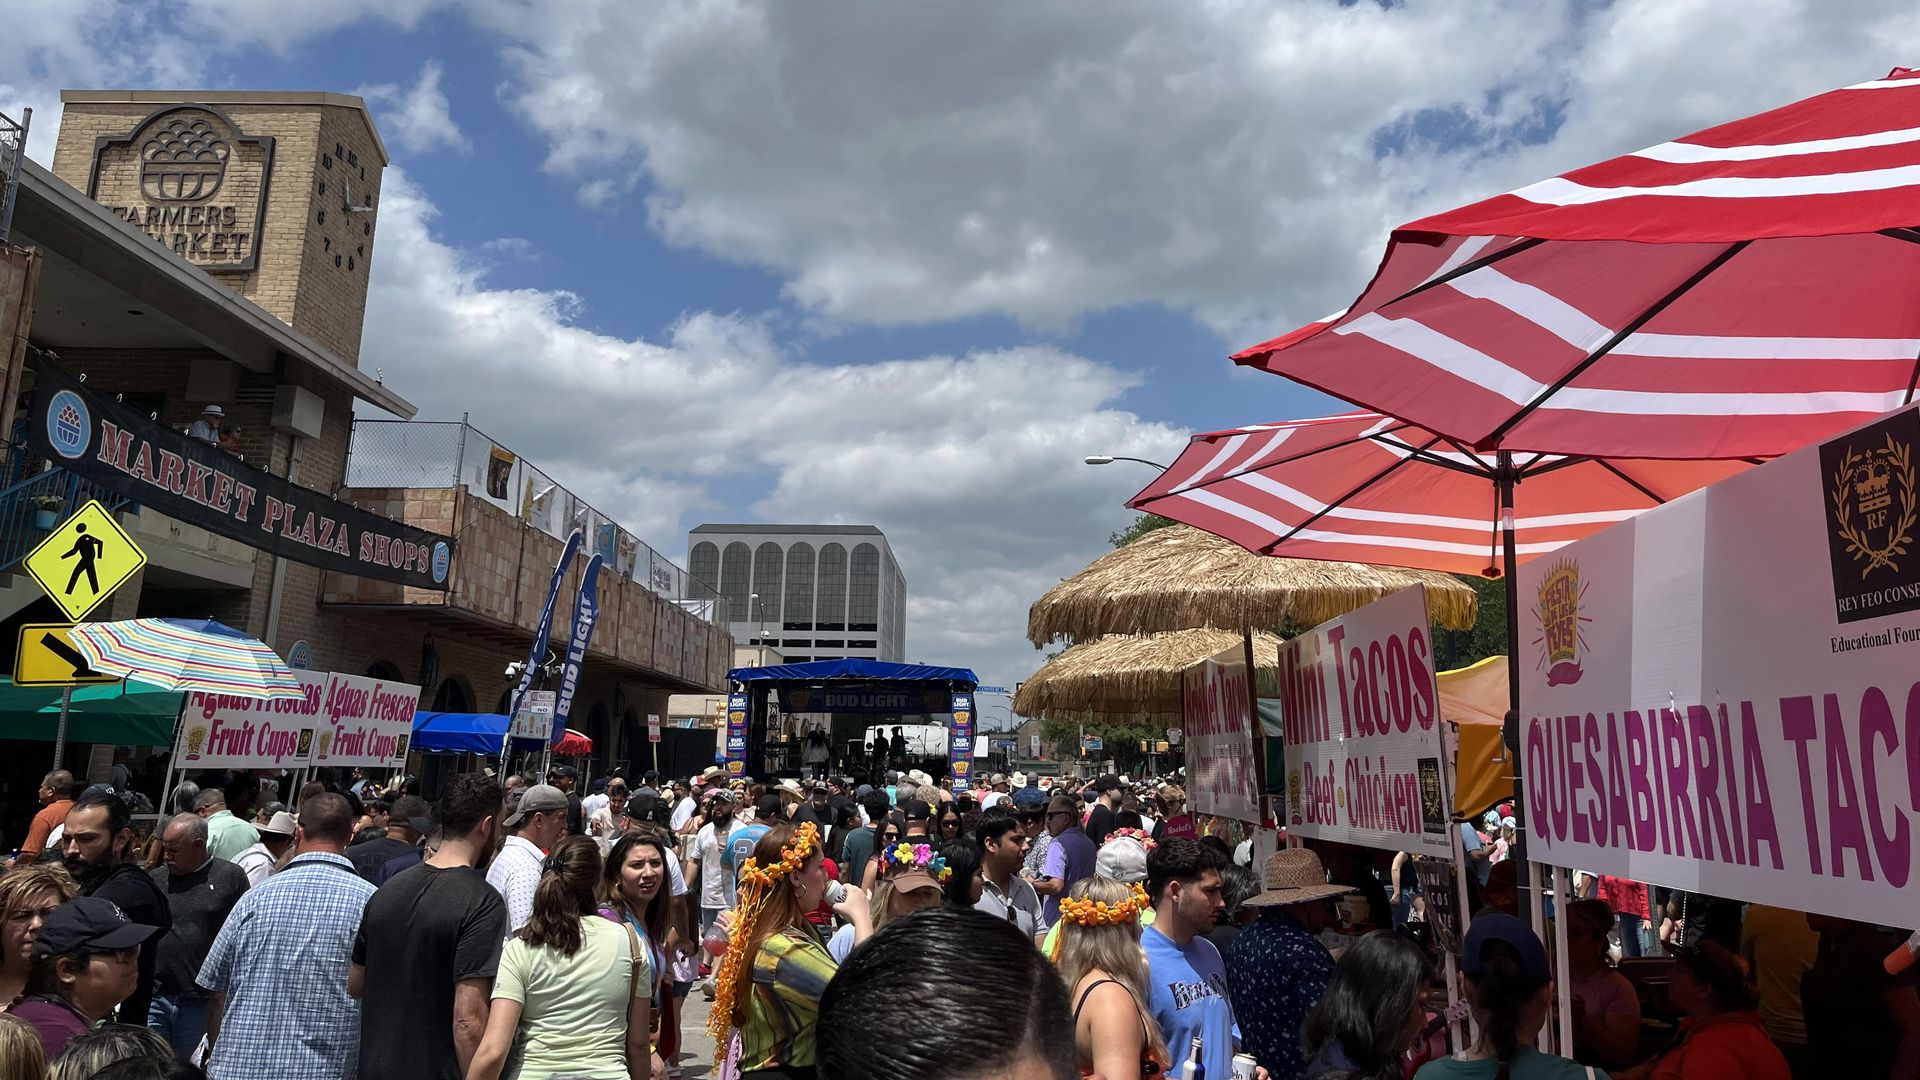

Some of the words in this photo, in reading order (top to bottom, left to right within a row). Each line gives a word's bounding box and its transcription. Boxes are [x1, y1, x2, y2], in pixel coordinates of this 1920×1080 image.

[149, 232, 249, 254] ARKET
[97, 418, 257, 522] MARKET
[261, 495, 350, 557] PLAZA
[359, 530, 429, 573] SHOPS
[1866, 509, 1888, 531] RF
[1838, 594, 1859, 613] REY
[1861, 590, 1882, 608] FEO
[556, 662, 580, 717] BUD
[569, 591, 595, 662] LIGHT
[1830, 629, 1891, 654] Educational
[322, 676, 369, 726] Aguas
[367, 683, 417, 723] Frescas
[825, 694, 859, 708] BUD
[861, 694, 909, 708] LIGHT
[1278, 633, 1330, 746] Mini
[1327, 624, 1434, 739] Tacos
[207, 719, 255, 756] Fruit
[256, 721, 298, 764] Cups
[331, 725, 366, 757] Fruit
[367, 727, 397, 763] Cups
[1304, 758, 1337, 826] Beef
[1345, 754, 1421, 834] Chicken
[1527, 700, 1784, 871] QUESABIRRIA
[1780, 681, 1920, 888] TAC
